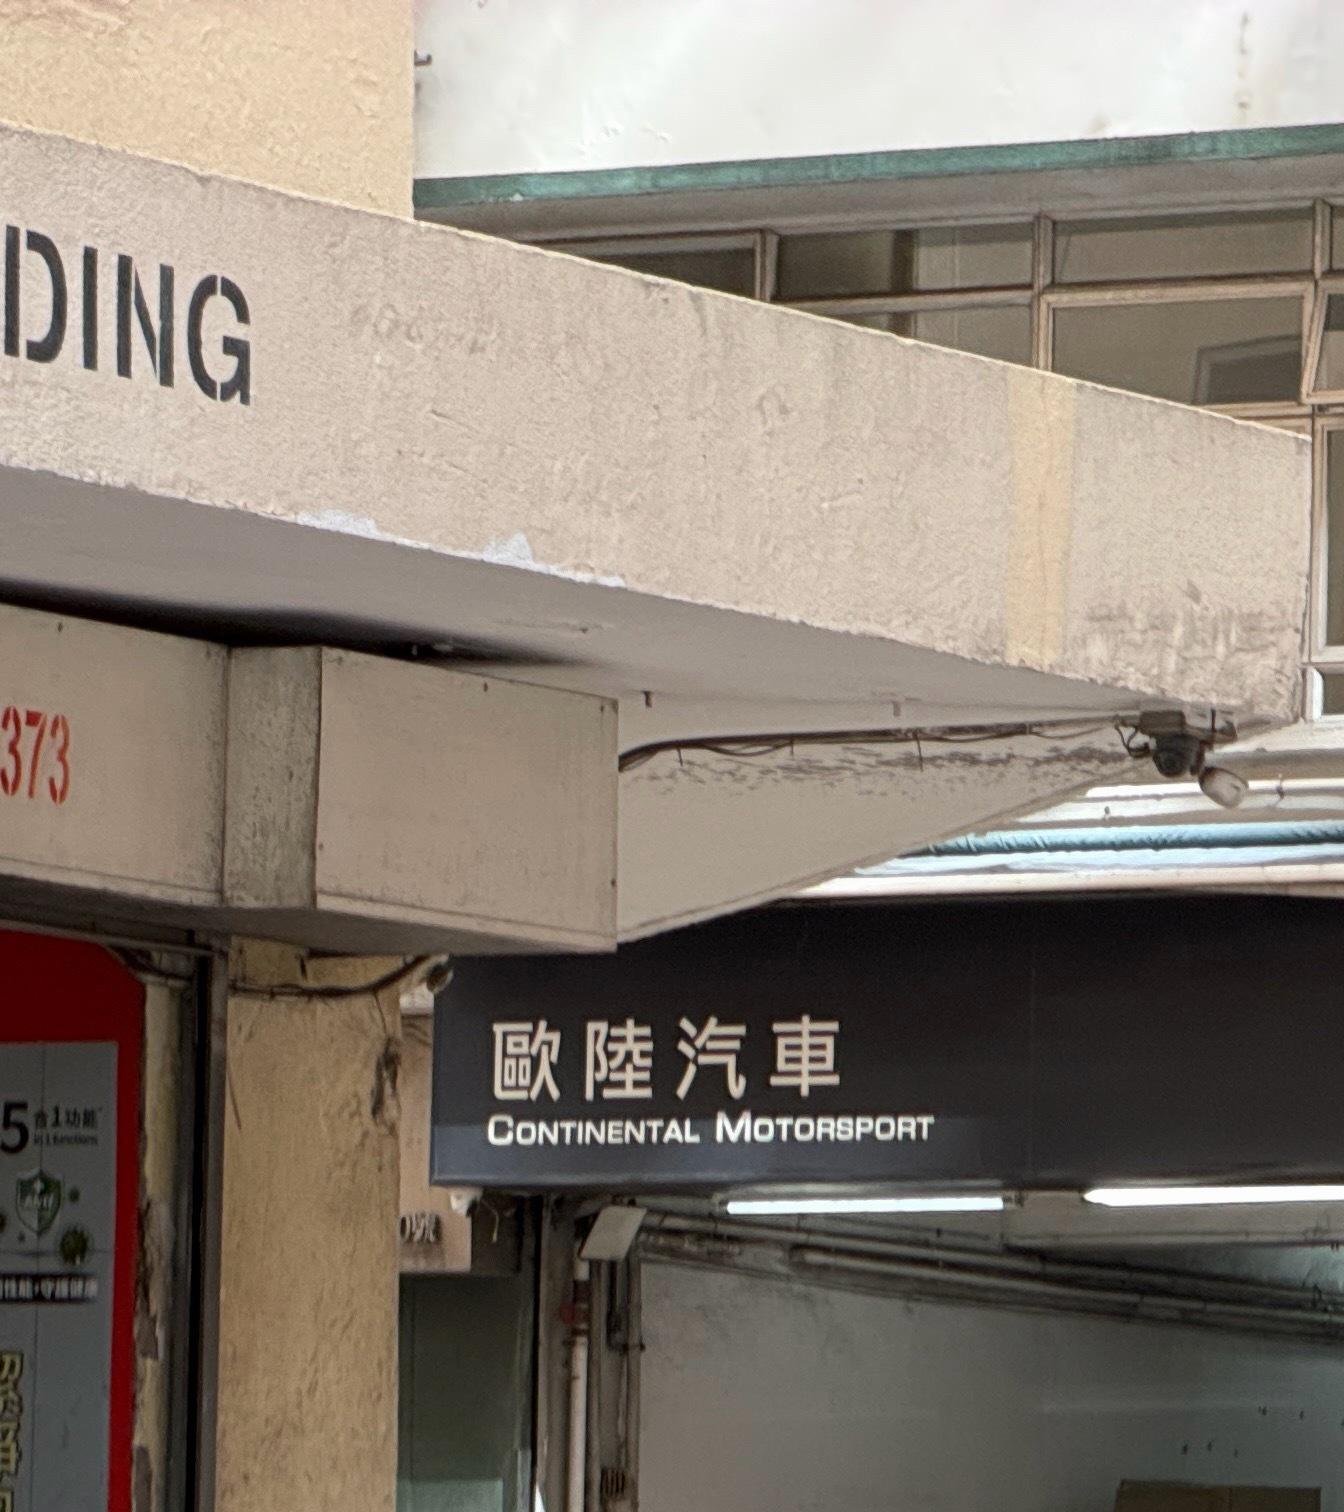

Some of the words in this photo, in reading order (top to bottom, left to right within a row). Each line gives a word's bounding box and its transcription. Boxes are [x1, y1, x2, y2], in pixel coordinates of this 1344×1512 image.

[4, 224, 251, 406] DING
[0, 706, 70, 804] 373
[491, 1013, 841, 1103] 歐陸汽車
